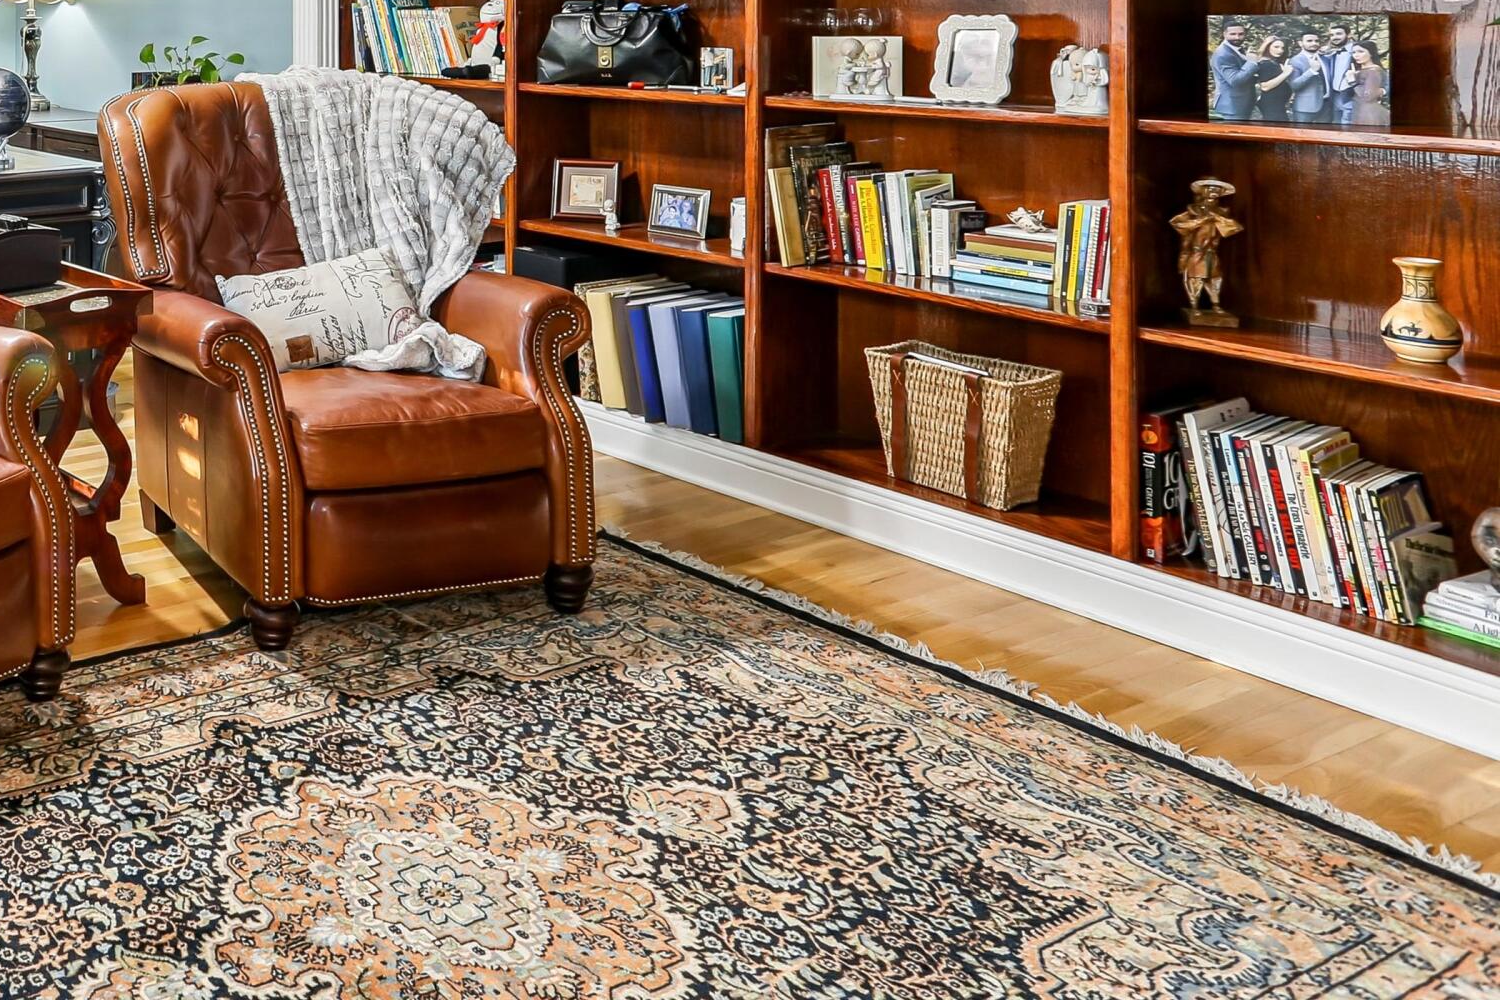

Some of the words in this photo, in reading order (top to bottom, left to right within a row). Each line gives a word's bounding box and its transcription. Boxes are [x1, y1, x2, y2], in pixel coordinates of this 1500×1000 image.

[290, 304, 320, 317] Paris
[1180, 426, 1190, 448] Larson
[1142, 452, 1155, 467] 101
[1187, 458, 1197, 472] The
[1190, 472, 1199, 483] Far
[1192, 483, 1203, 499] Side
[1286, 491, 1297, 505] The
[1195, 498, 1212, 541] GALLERY
[1229, 514, 1238, 527] FAR
[1238, 509, 1246, 520] Far
[1268, 467, 1286, 510] PEARLS
[1278, 511, 1294, 545] SELLS
[1287, 546, 1301, 571] OUT
[1289, 504, 1302, 524] Crass
[1232, 526, 1241, 539] SIDE
[1240, 519, 1249, 534] Side
[1266, 502, 1275, 522] CALVIN
[1274, 535, 1283, 557] HOBBES
[1293, 523, 1310, 560] Menagerie
[1243, 533, 1256, 566] GALLERY
